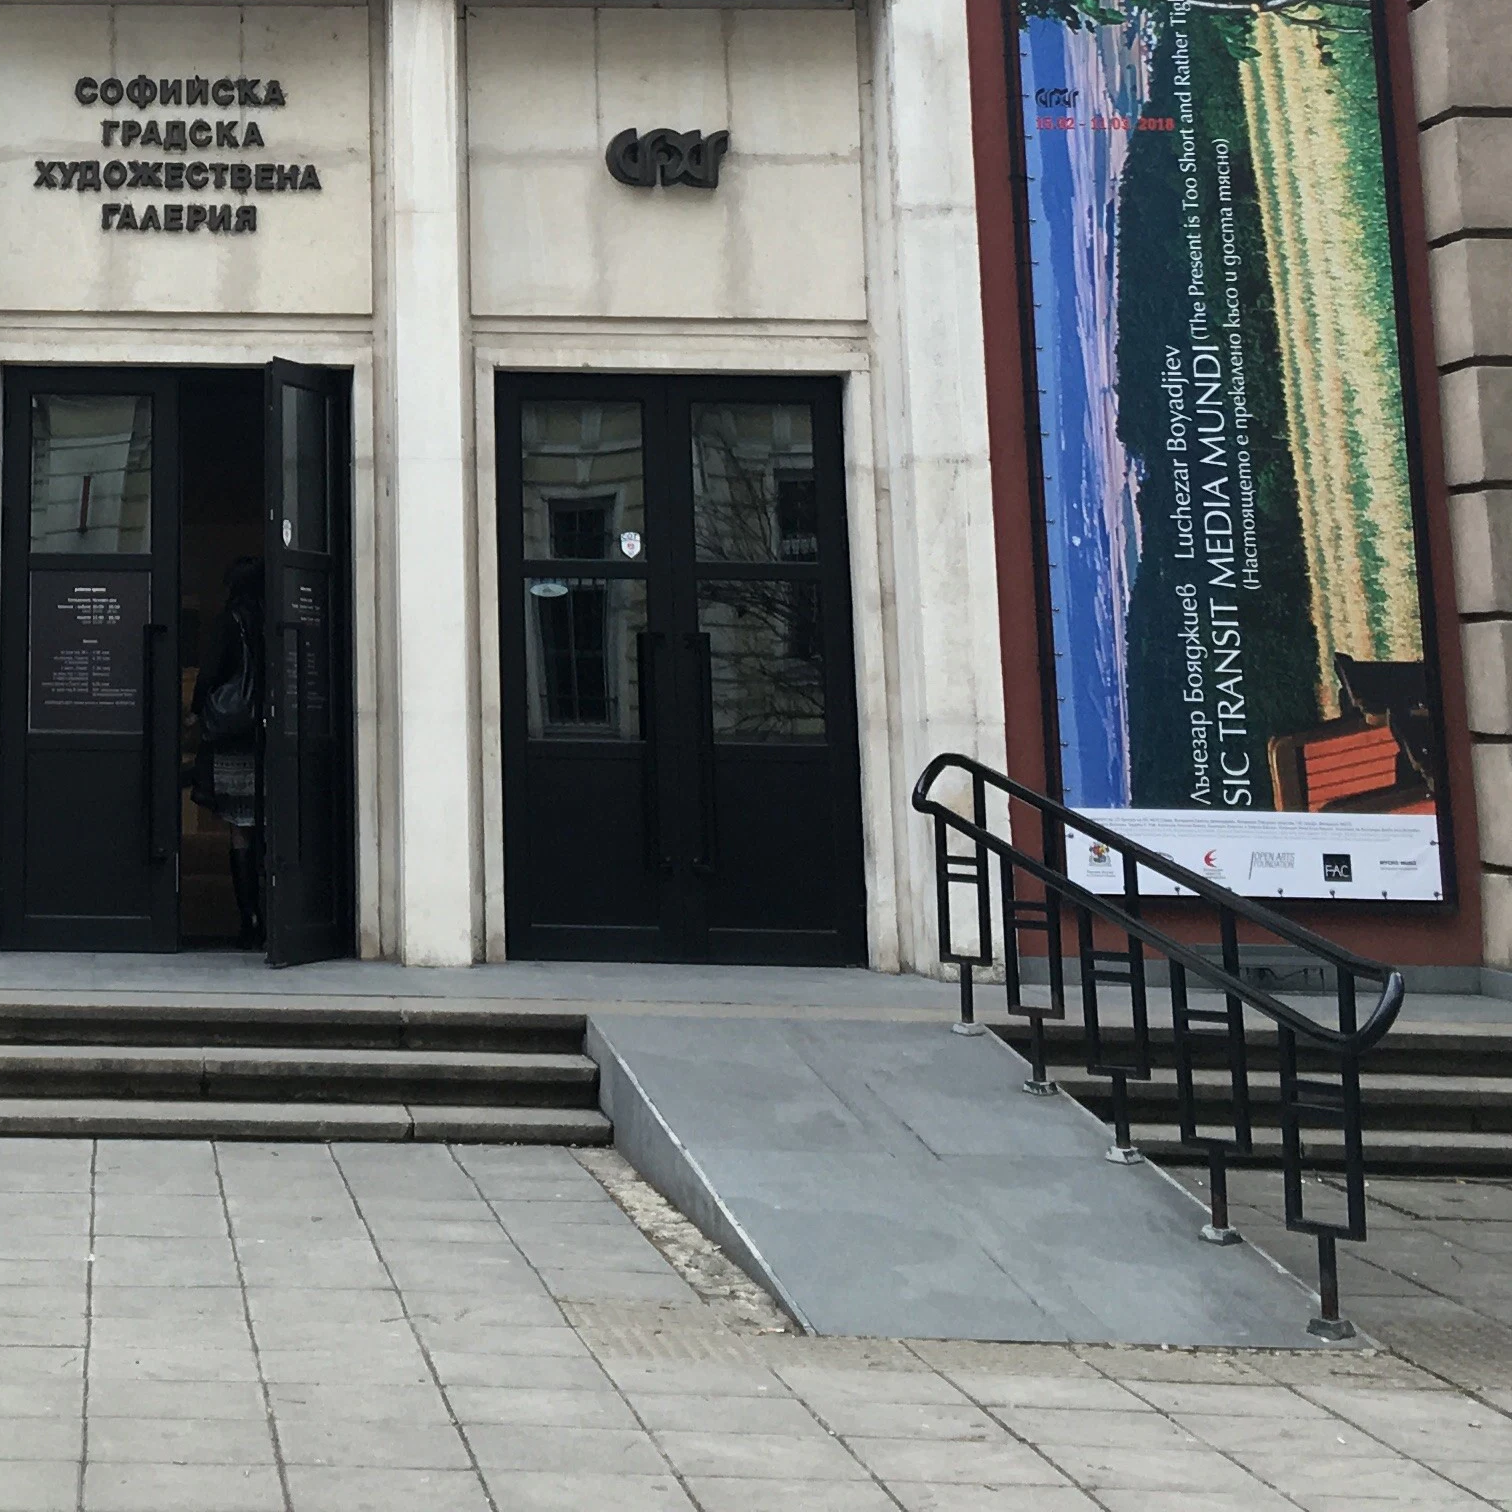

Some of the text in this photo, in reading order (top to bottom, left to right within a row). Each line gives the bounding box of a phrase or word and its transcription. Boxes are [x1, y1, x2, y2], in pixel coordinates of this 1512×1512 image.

[1171, 31, 1191, 86] Rather
[75, 75, 287, 109] СОФИЙСКА
[1174, 92, 1194, 123] and
[101, 119, 265, 152] ГРАДСКА
[1178, 129, 1198, 173] Short
[34, 160, 322, 192] ХУДОЖЕСТВЕНА
[1182, 177, 1200, 211] Too
[101, 203, 258, 232] ГАЛЕРИЯ
[1183, 215, 1201, 228] is
[1186, 231, 1205, 296] Present
[1189, 301, 1210, 340] (The
[1211, 138, 1262, 590] (Настоящето е прекалено късо и доста тясно)
[1161, 345, 1195, 559] Luchezar Boyadjiev
[1192, 345, 1252, 806] SIC TRANSIT MEDIA MUNDI
[1175, 583, 1213, 805] Лъчезар Бояджиев
[1325, 864, 1350, 878] FAC
